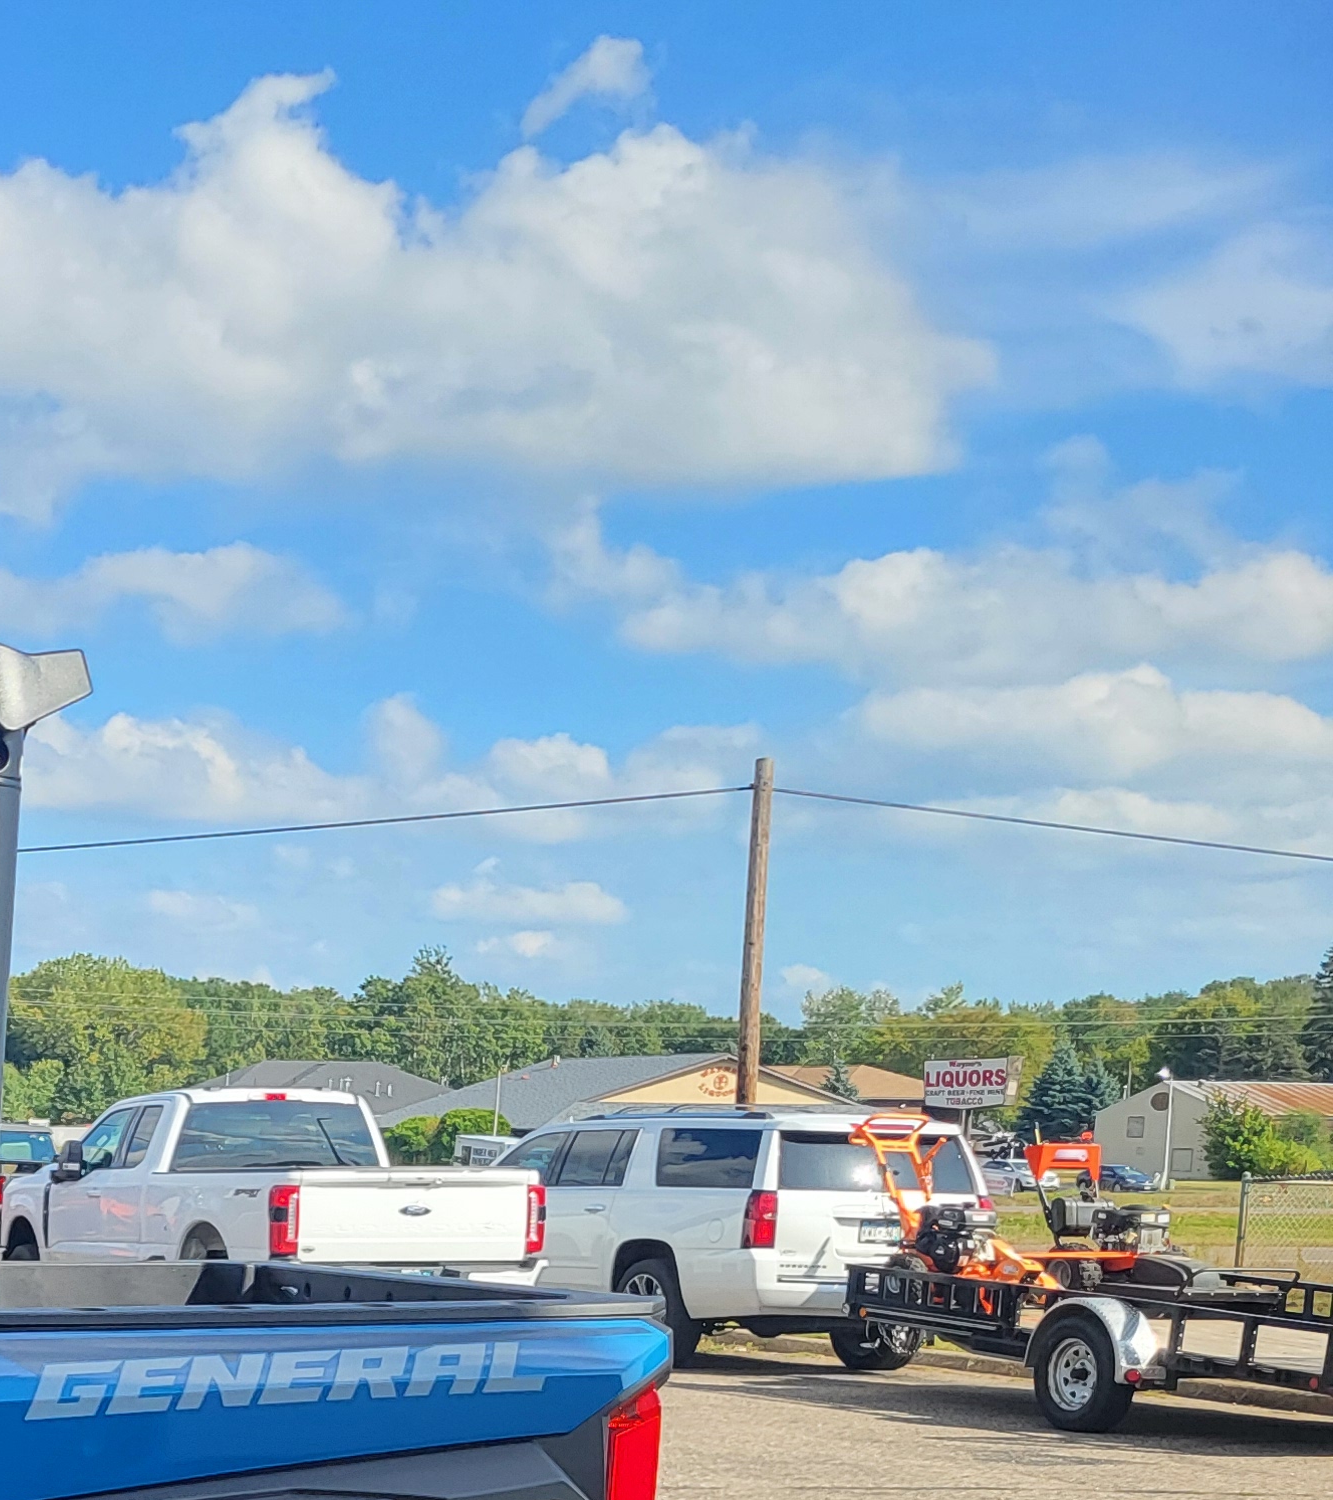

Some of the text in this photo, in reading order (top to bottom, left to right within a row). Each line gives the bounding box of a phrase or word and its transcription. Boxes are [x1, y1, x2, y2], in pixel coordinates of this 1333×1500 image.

[925, 1069, 1007, 1088] LIQUORS
[945, 1097, 983, 1105] TOBACCO
[25, 1341, 547, 1420] GENERAL
